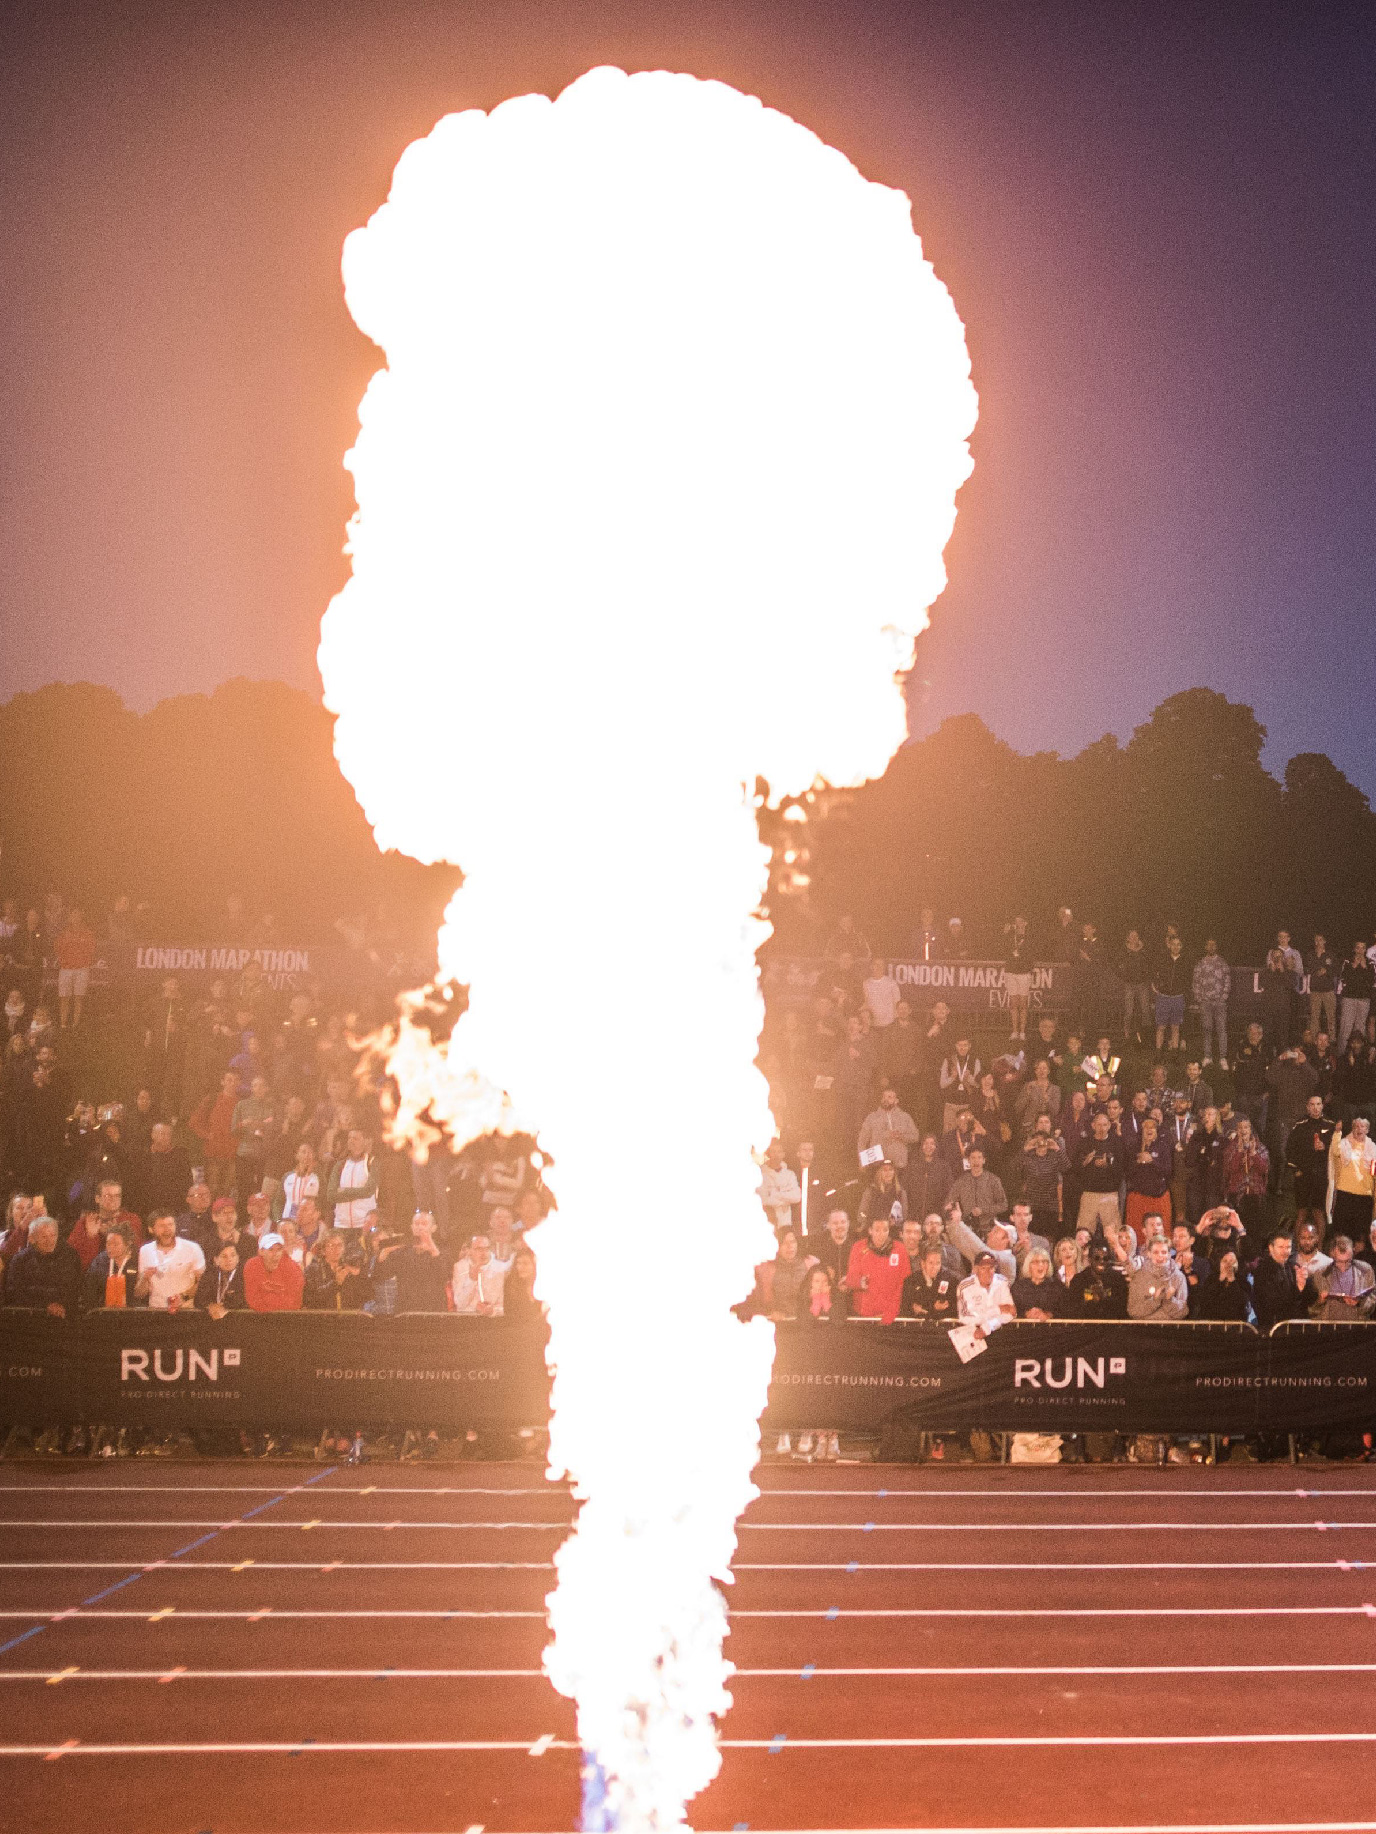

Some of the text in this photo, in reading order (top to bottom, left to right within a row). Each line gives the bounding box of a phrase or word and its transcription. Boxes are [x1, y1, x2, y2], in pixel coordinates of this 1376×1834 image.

[137, 947, 206, 969] LONDON
[121, 1349, 218, 1381] RUN
[315, 1369, 500, 1380] PRODIRECTRUNNING.COM
[1014, 1357, 1105, 1388] RUN
[1195, 1377, 1368, 1387] PRODIRECTRUNNING.COM
